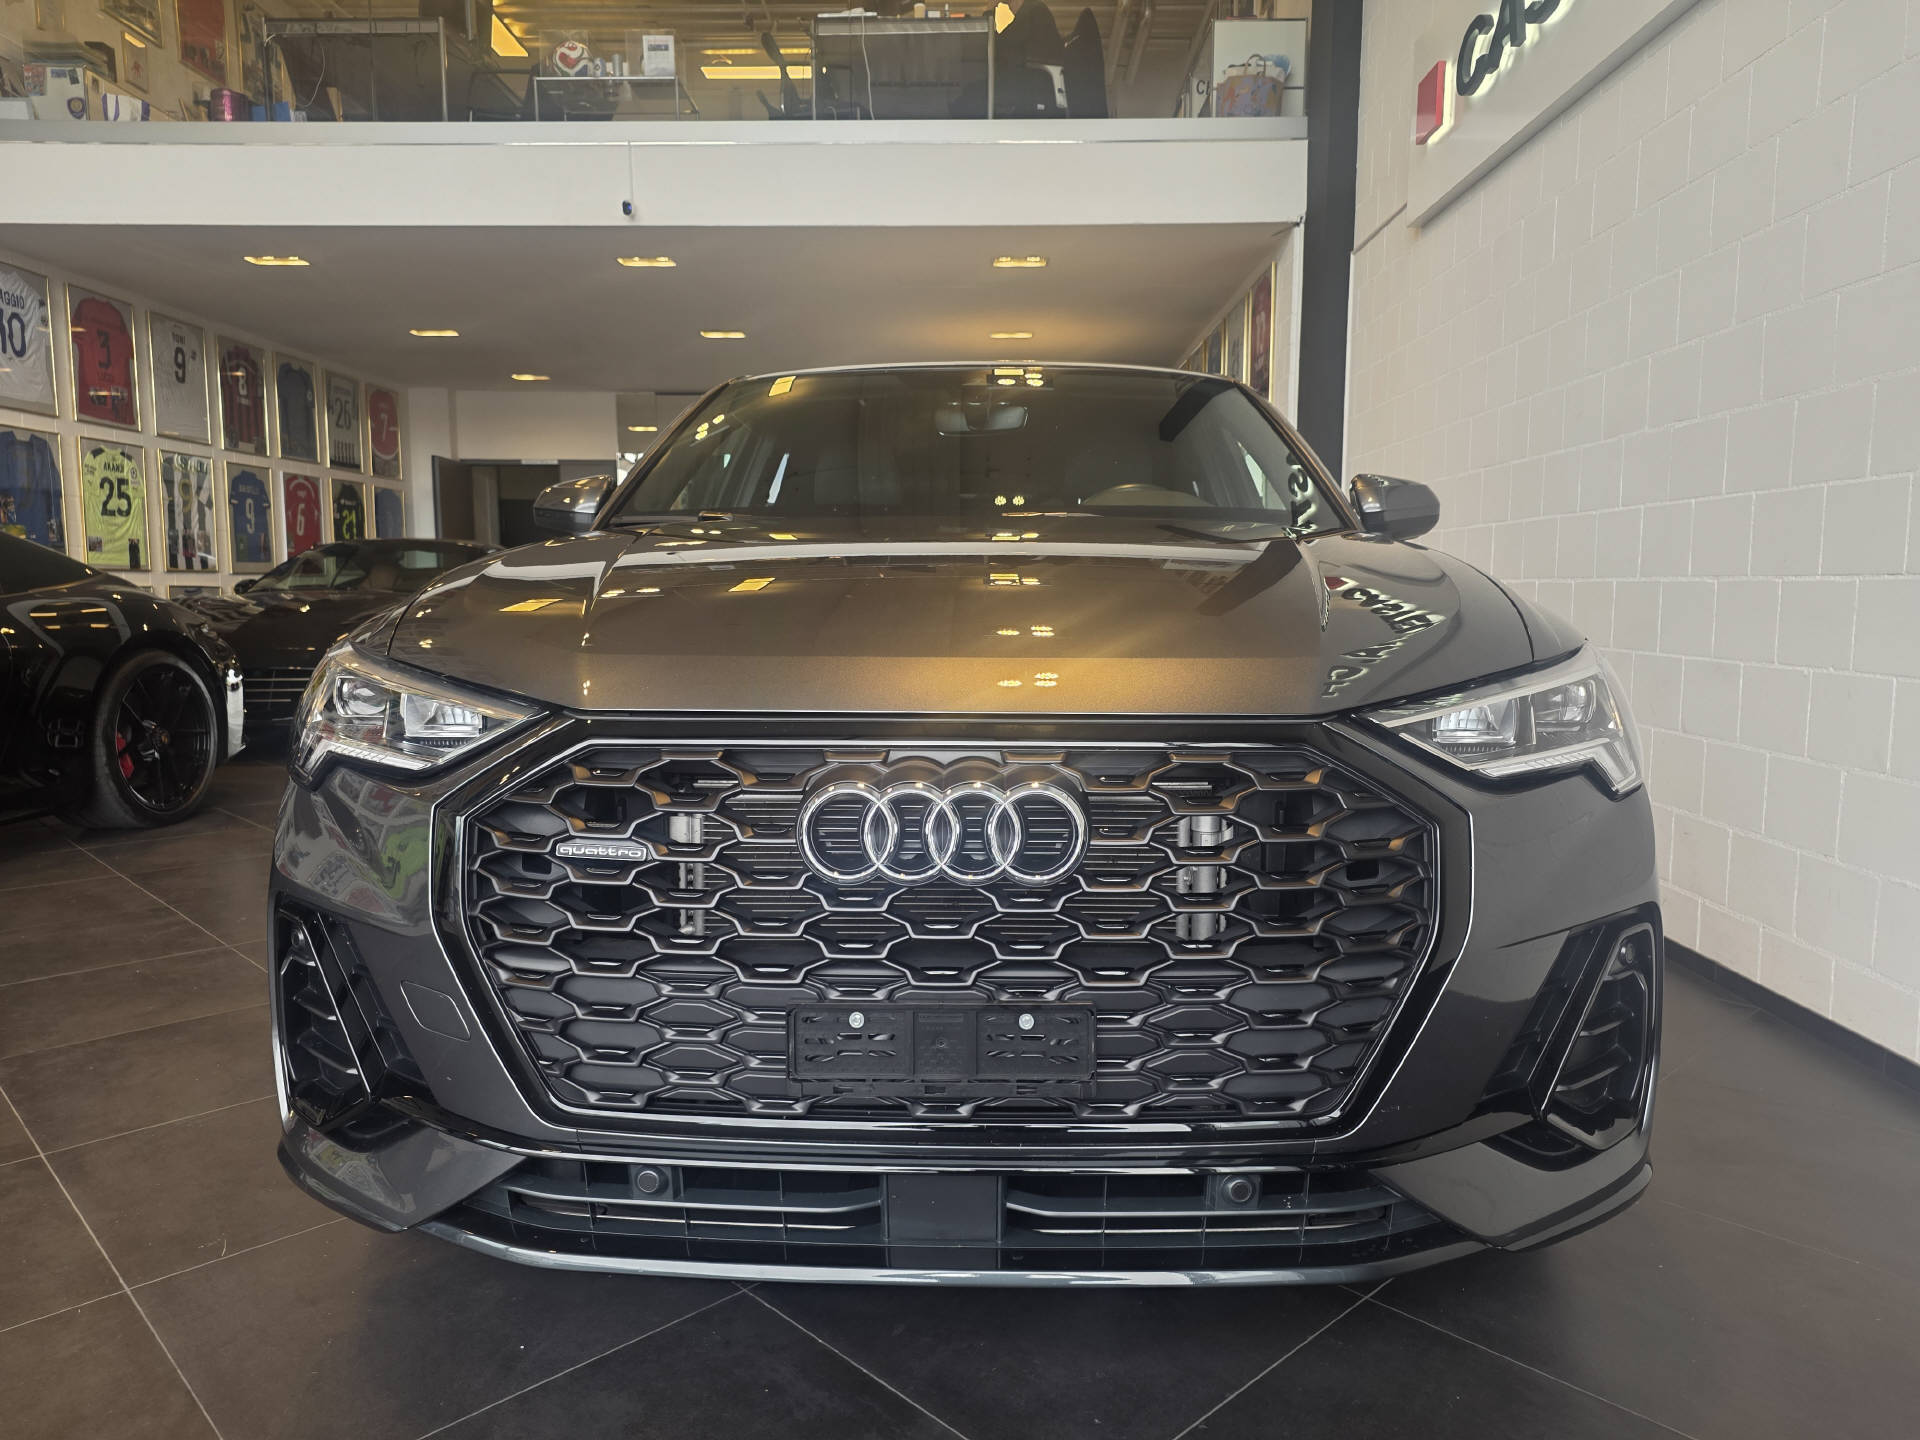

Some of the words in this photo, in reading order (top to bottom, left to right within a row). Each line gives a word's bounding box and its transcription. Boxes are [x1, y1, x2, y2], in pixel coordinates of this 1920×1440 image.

[97, 329, 112, 369] 3
[174, 346, 186, 384] 9
[380, 413, 388, 441] 7
[99, 476, 132, 517] 25
[245, 497, 256, 535] 9
[296, 503, 306, 536] 6
[342, 509, 358, 540] 21
[560, 846, 641, 857] quattro
